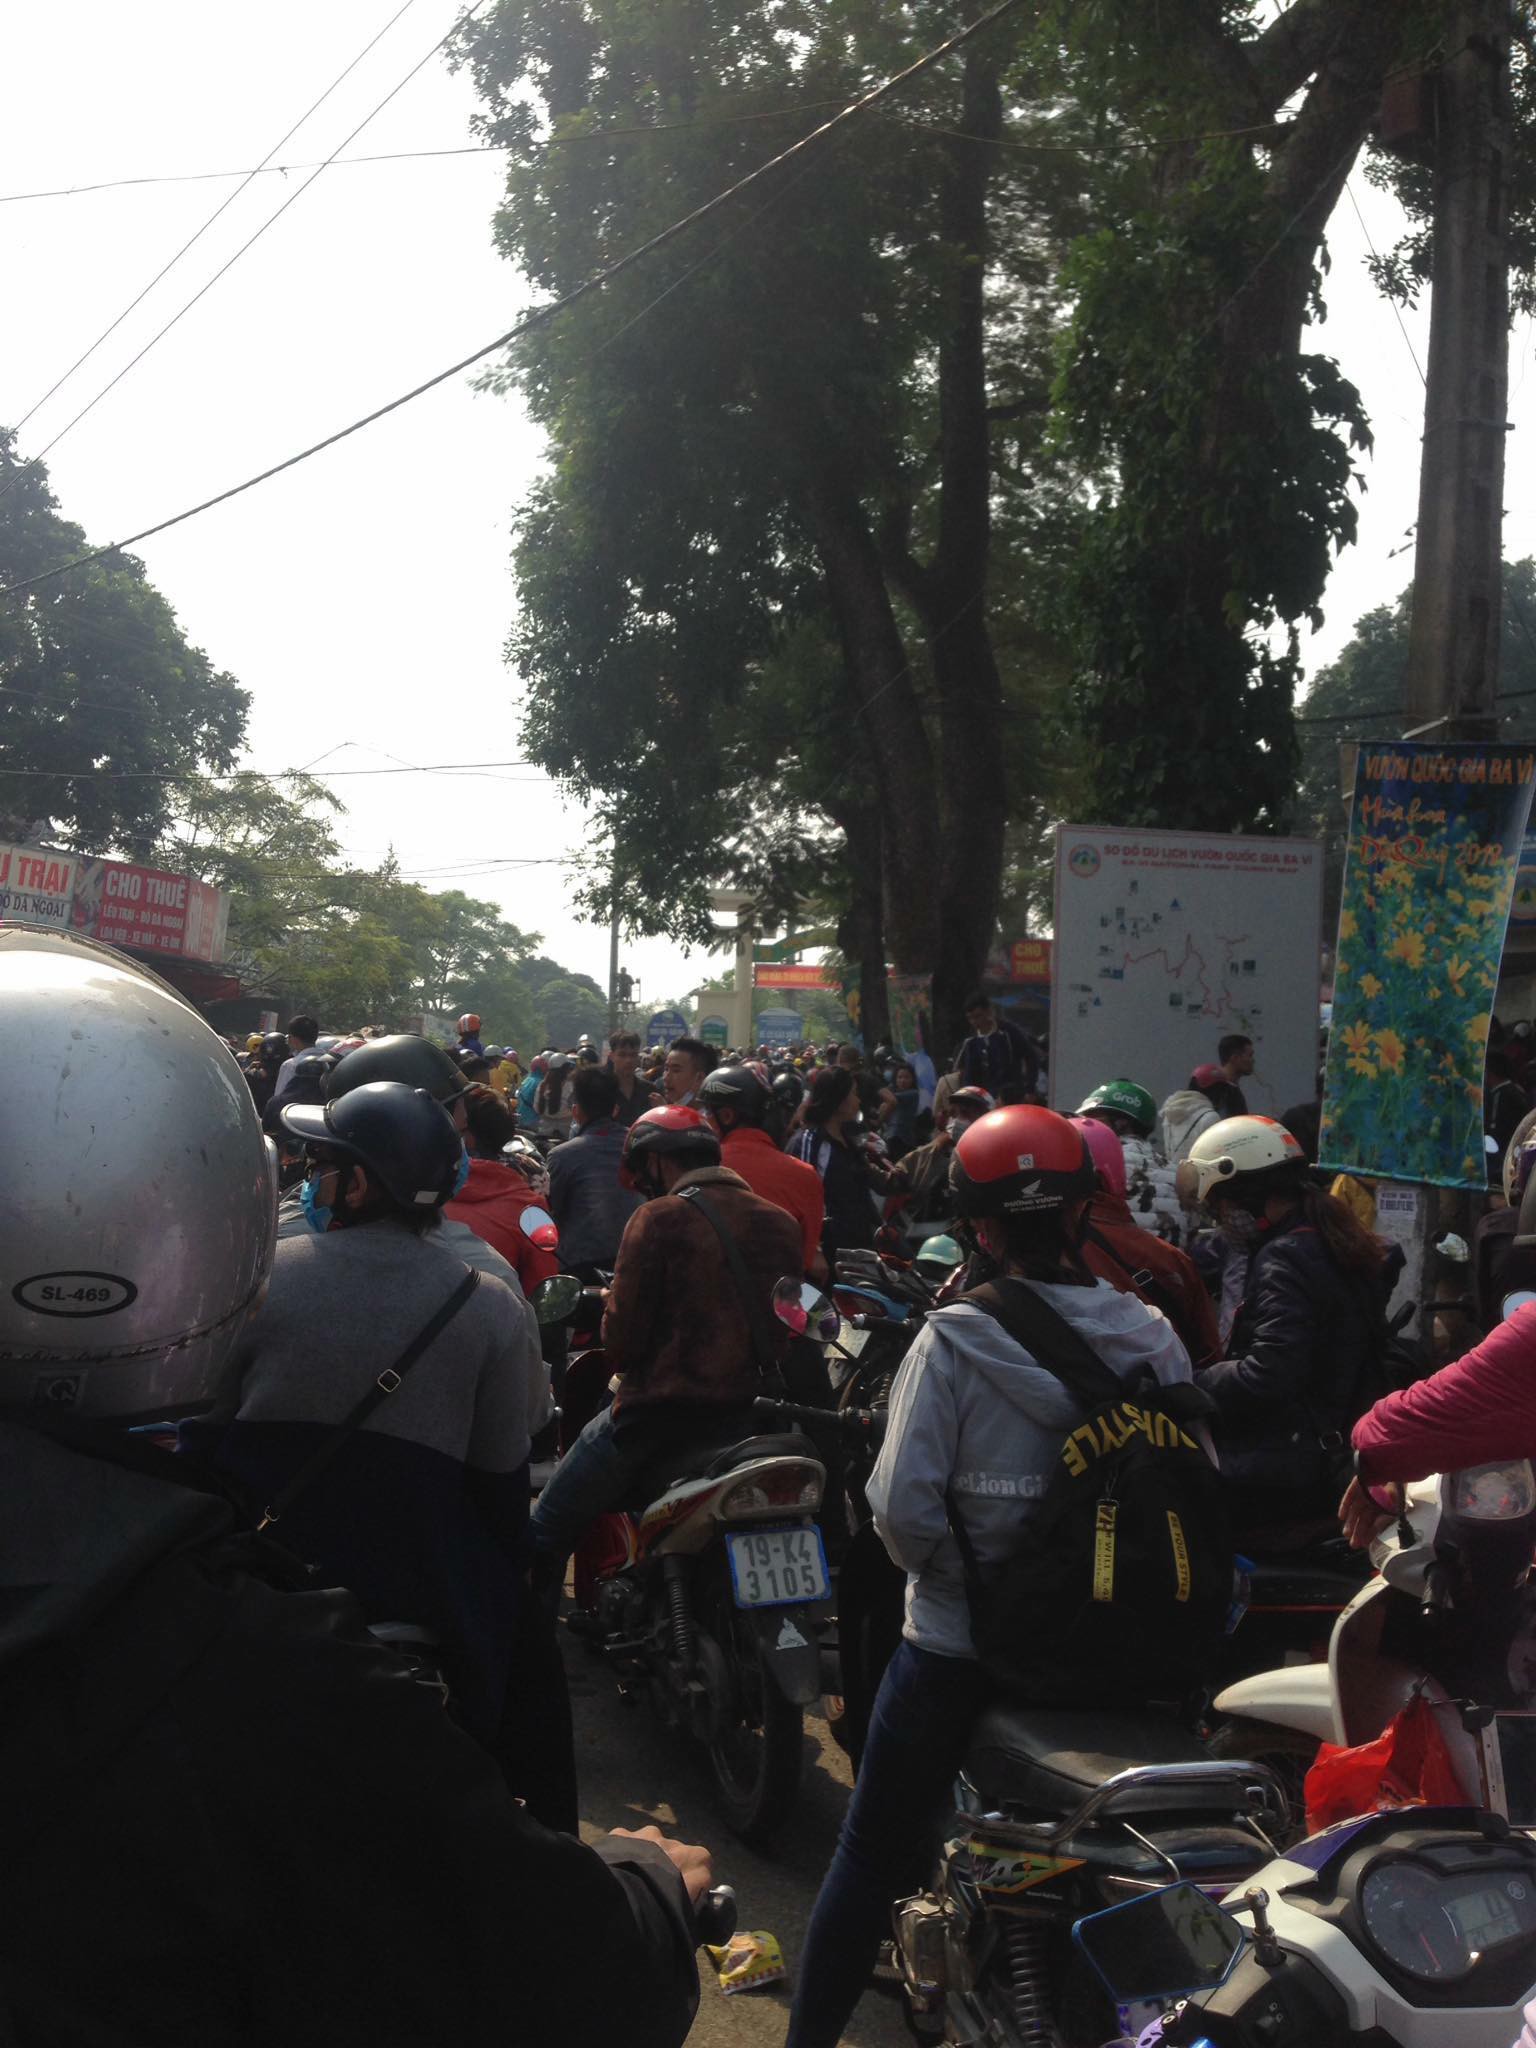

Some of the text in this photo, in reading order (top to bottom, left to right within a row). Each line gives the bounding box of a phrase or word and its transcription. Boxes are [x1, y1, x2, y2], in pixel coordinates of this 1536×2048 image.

[18, 856, 69, 897] TRẠI
[107, 870, 187, 909] CHO THUÊ
[31, 897, 65, 920] NGOẠI
[1112, 1091, 1142, 1108] Grab
[41, 1285, 112, 1302] SL-469
[746, 1565, 817, 1600] 3105
